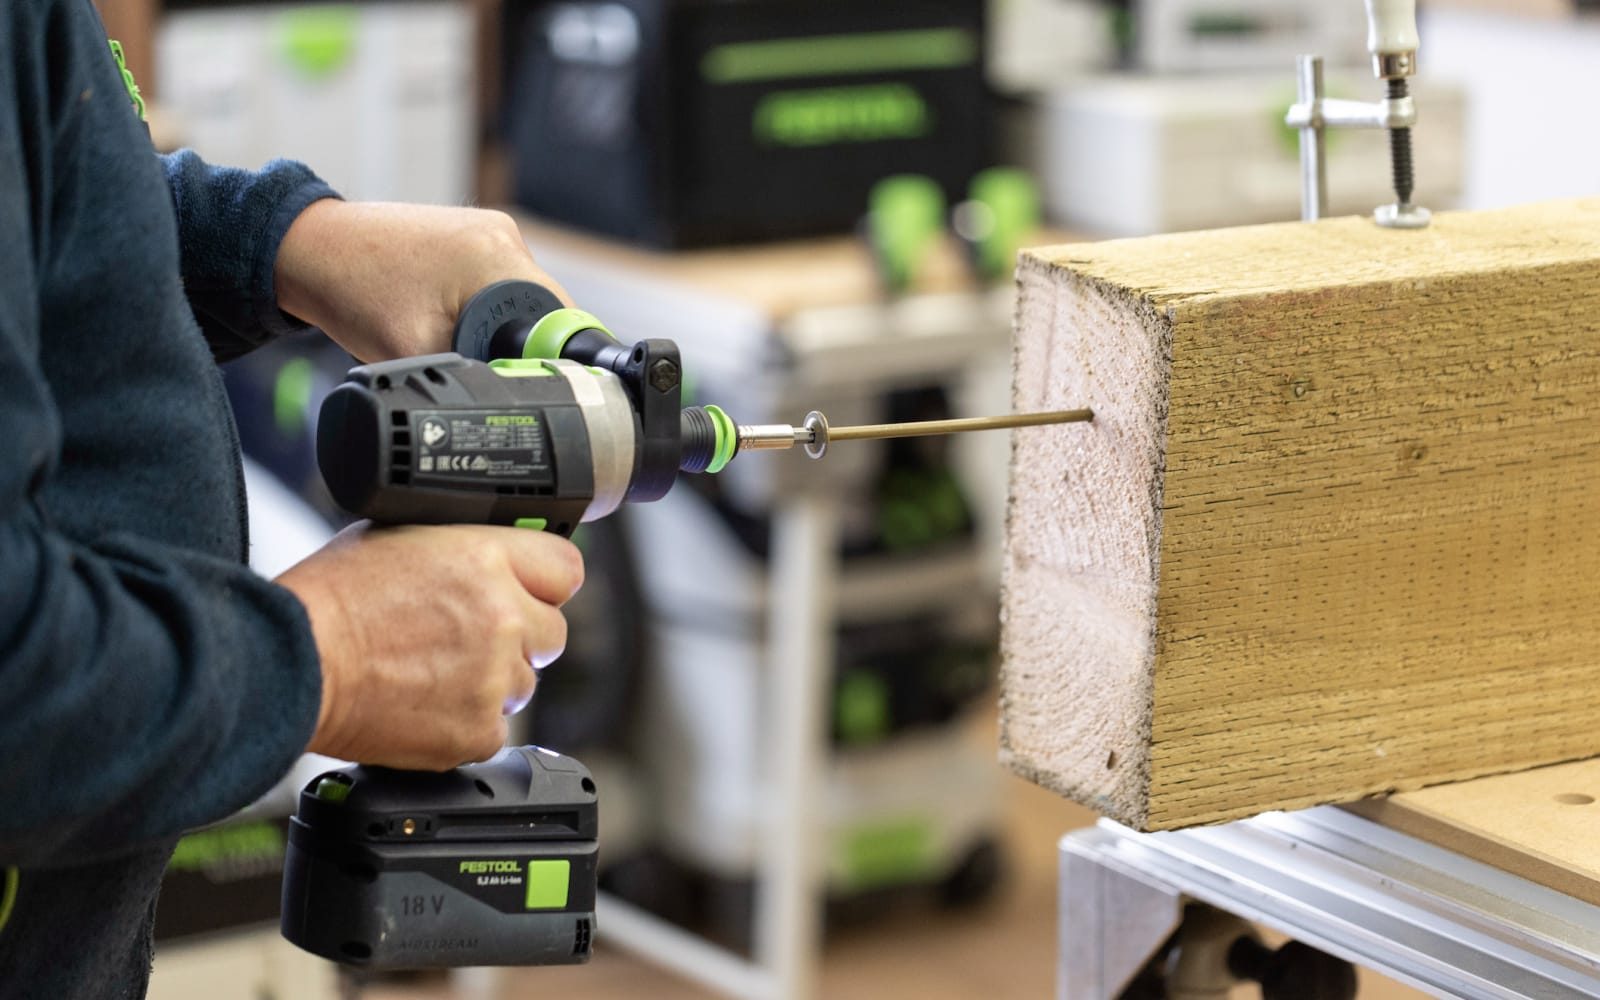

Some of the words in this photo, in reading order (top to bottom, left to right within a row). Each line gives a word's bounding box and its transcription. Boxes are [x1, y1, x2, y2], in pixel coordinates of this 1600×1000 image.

[486, 415, 538, 426] FESTOOL
[460, 861, 522, 873] FESTOOL
[401, 895, 425, 916] 18
[431, 895, 445, 916] V
